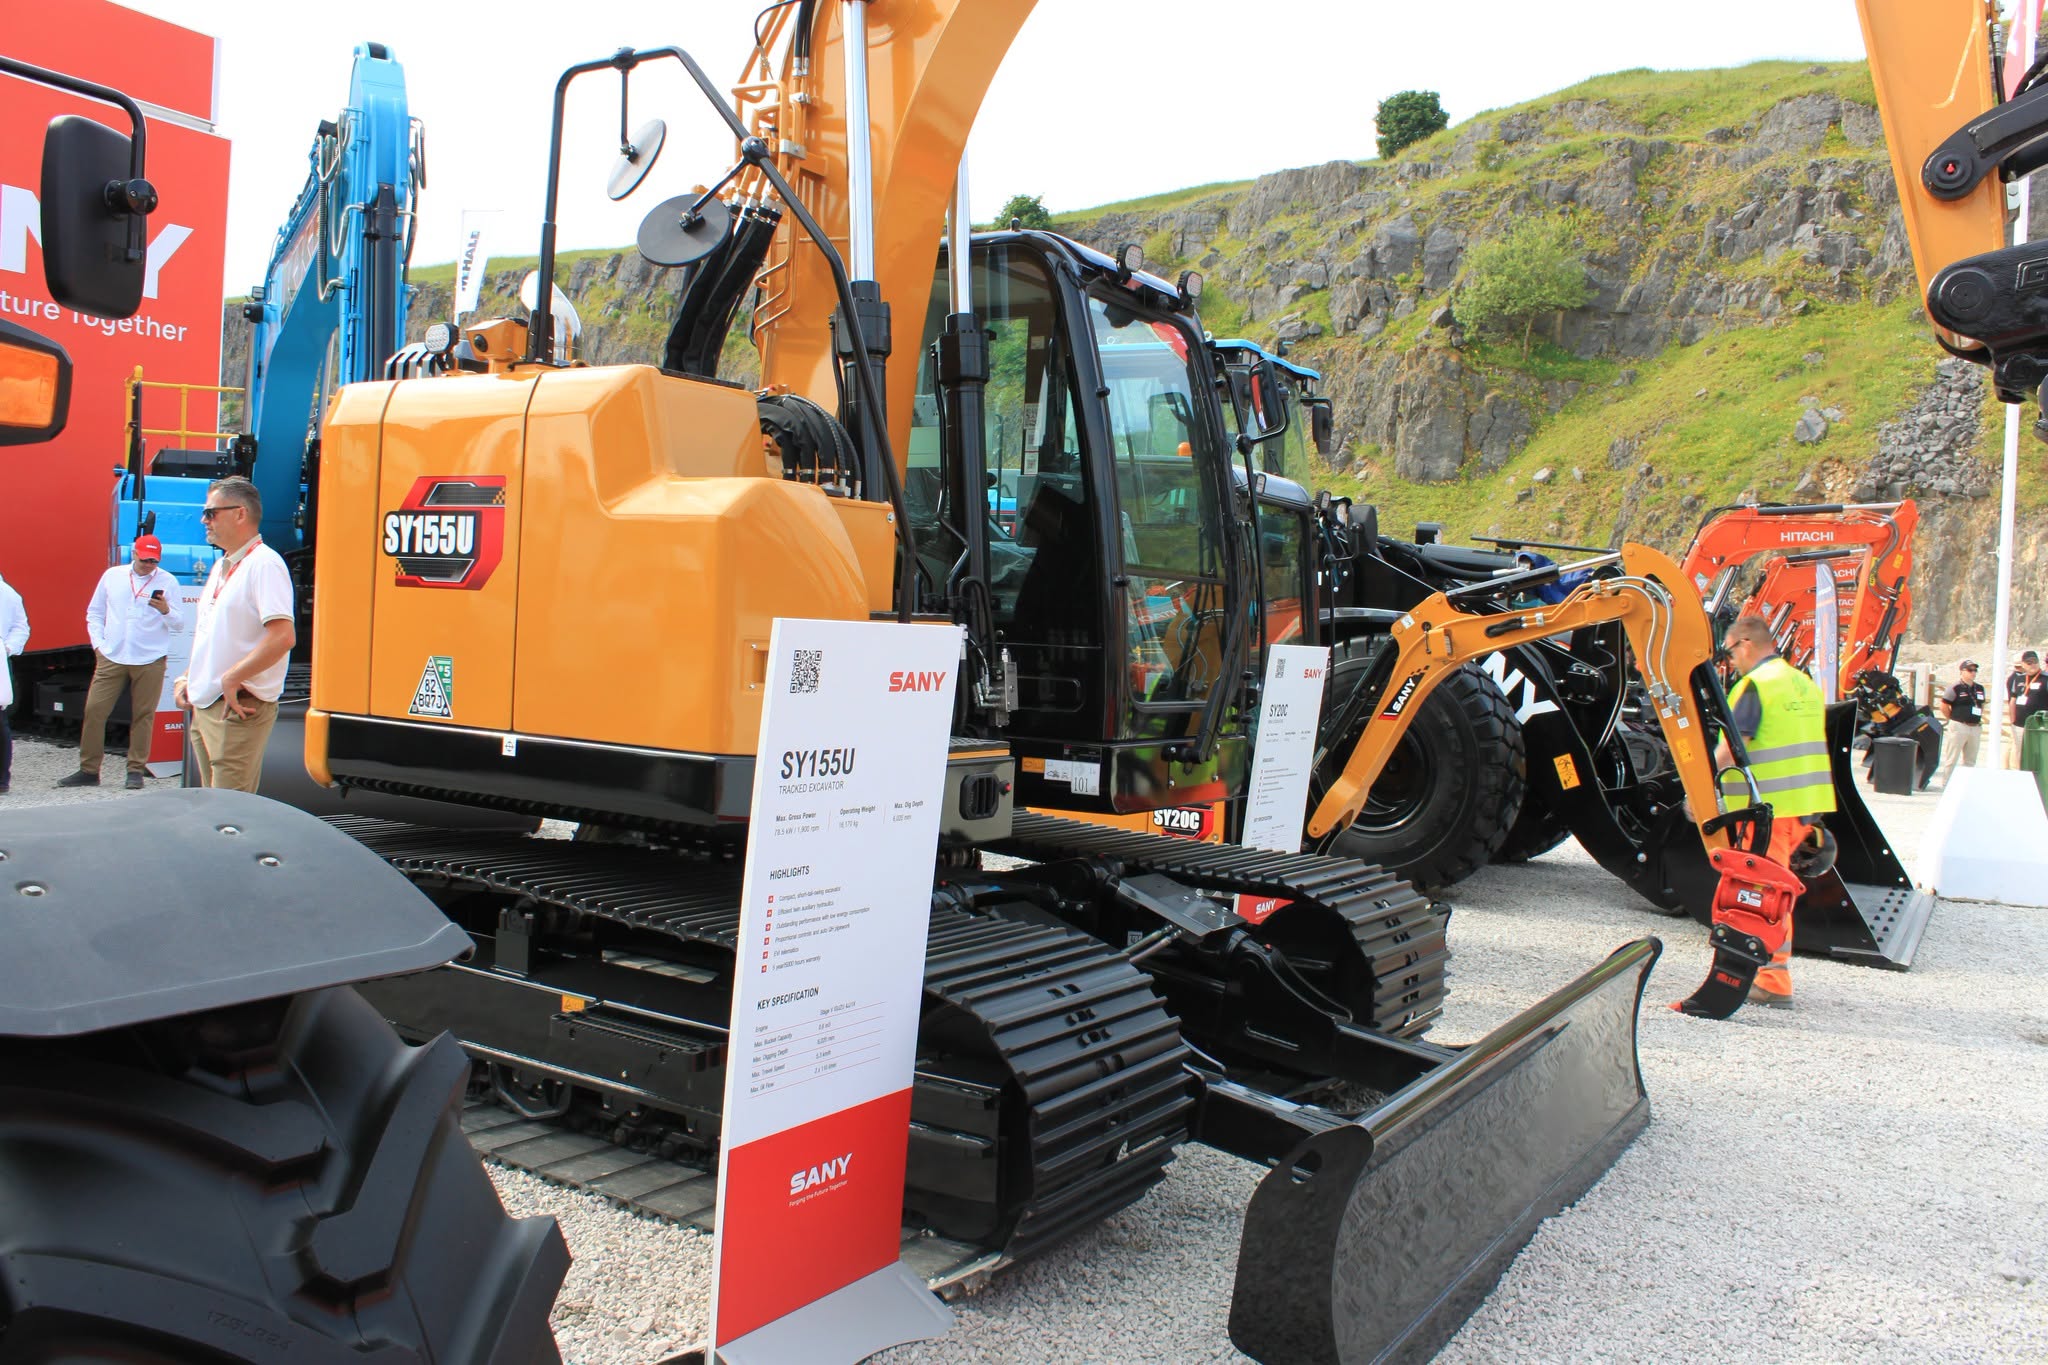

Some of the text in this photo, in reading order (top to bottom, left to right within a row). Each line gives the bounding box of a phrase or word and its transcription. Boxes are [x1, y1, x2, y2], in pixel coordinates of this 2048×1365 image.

[0, 291, 60, 320] ture
[384, 514, 475, 555] SY155U
[1780, 531, 1834, 542] HITACHI
[1838, 598, 1856, 606] TAC
[889, 671, 946, 692] SANY
[1303, 669, 1322, 679] SANY
[425, 679, 436, 693] 82
[1392, 677, 1416, 712] SANY
[1269, 704, 1288, 717] SY20C
[780, 748, 855, 779] SY155U
[779, 781, 844, 795] TRACKED EXCAVATOR
[1074, 777, 1088, 792] 101
[789, 813, 802, 821] Gross
[840, 805, 876, 816] Operating Weight
[1153, 809, 1200, 829] SY20C
[769, 865, 810, 880] HIGHLIGHTS
[1256, 900, 1276, 914] SANY
[758, 987, 819, 1010] KEY SPECIFICATION
[790, 1152, 853, 1196] SANY
[789, 1196, 806, 1207] Forging
[814, 1187, 829, 1197] Future
[829, 1180, 848, 1191] Together
